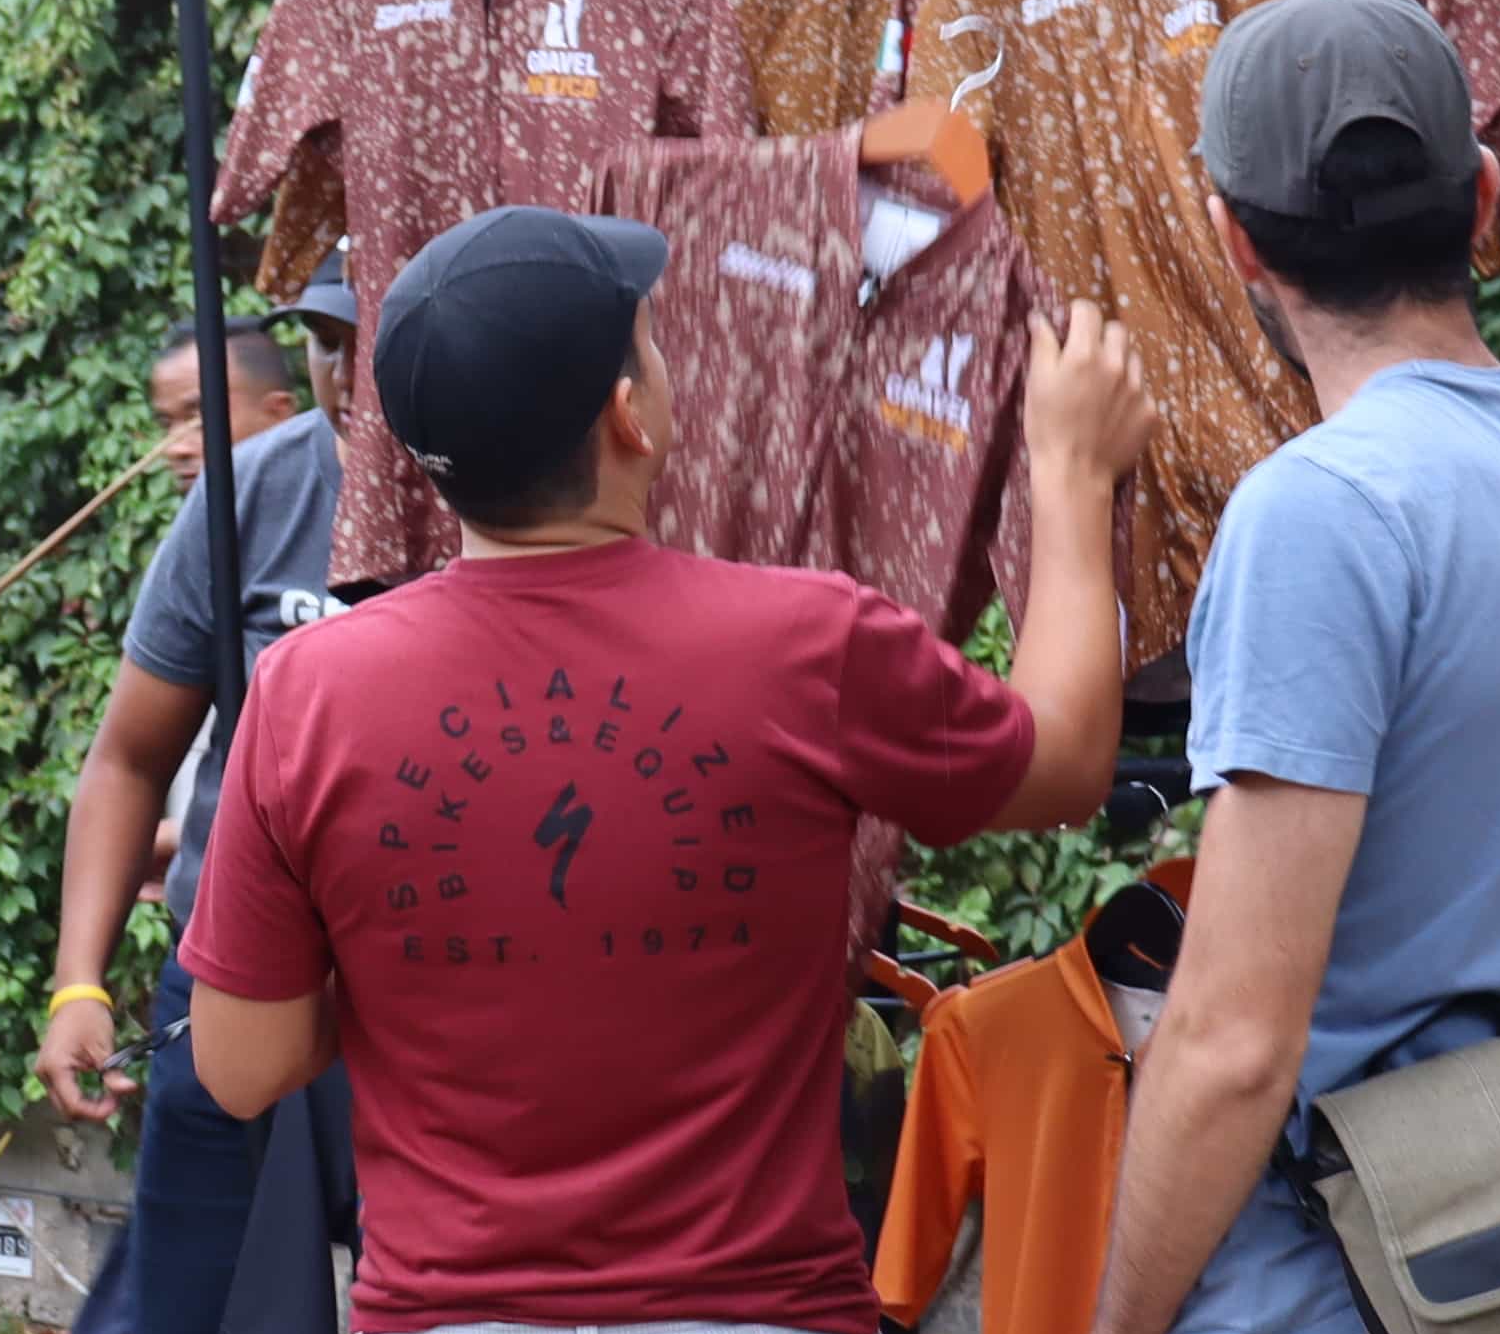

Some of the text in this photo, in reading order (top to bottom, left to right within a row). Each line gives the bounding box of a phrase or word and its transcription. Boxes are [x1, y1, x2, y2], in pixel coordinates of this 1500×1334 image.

[380, 669, 756, 909] SPECIALIZED
[433, 725, 527, 901] BIKES
[547, 715, 573, 743] &
[404, 921, 752, 964] EST. 1974
